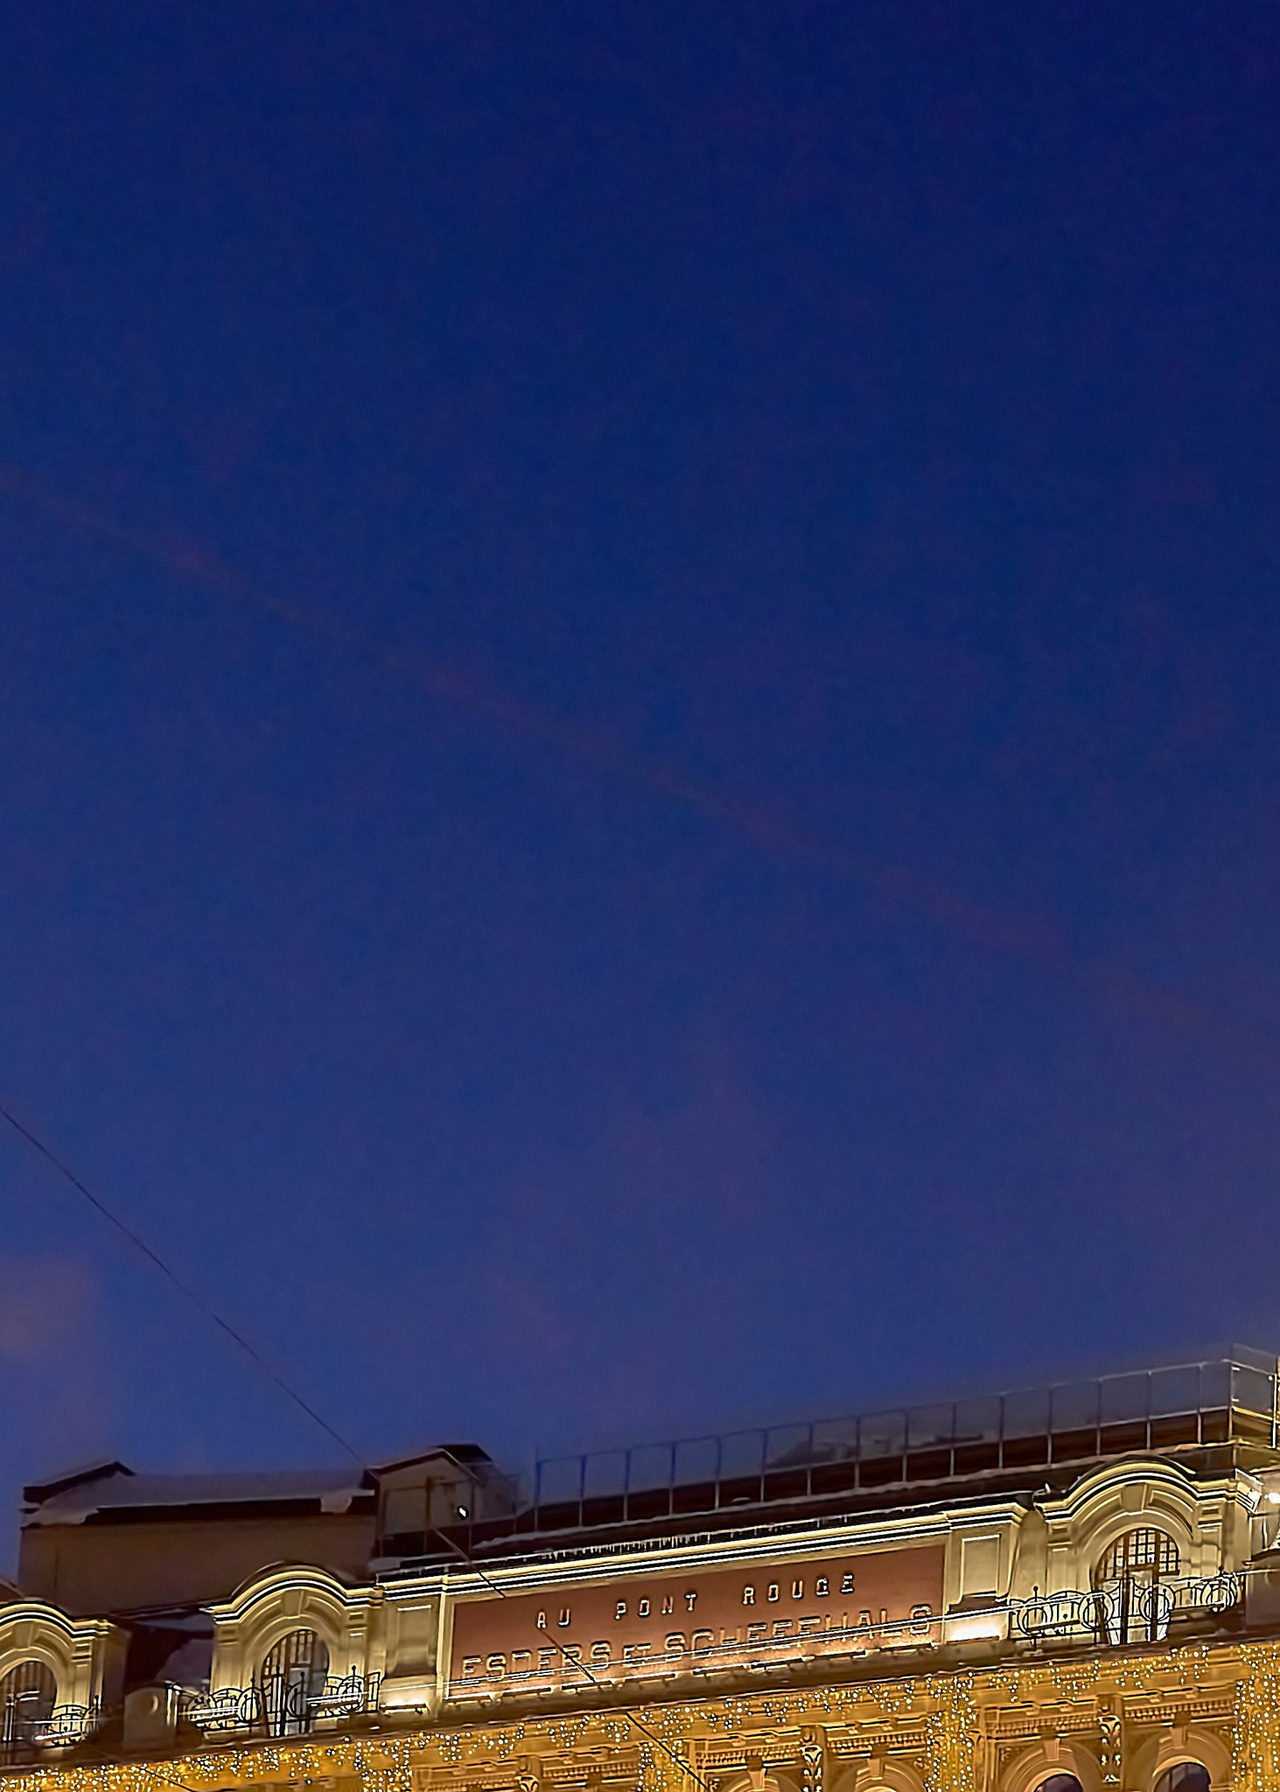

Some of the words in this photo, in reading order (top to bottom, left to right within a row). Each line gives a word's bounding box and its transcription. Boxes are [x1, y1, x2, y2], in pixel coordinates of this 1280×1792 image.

[537, 1608, 570, 1628] AU
[615, 1593, 697, 1619] PONT
[742, 1574, 855, 1605] ROUGE
[462, 1640, 611, 1683] ESDERS
